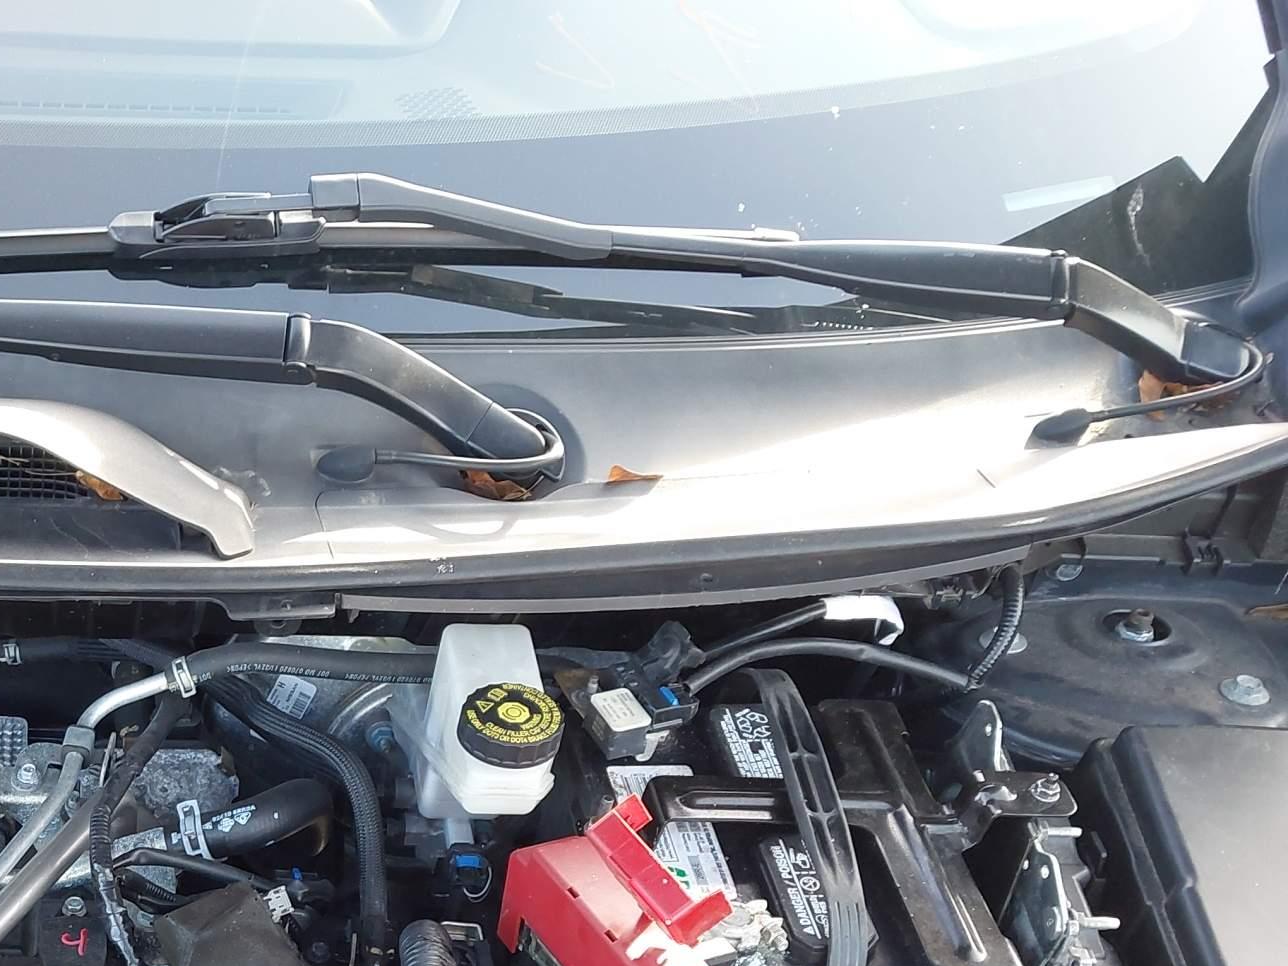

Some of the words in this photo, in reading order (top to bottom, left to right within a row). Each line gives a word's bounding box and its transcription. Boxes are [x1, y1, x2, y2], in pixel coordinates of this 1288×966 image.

[485, 721, 506, 735] CLEAN
[506, 729, 530, 737] FILLER
[499, 734, 510, 742] OR
[769, 845, 793, 879] POISON
[784, 879, 796, 887] /
[787, 887, 812, 926] DANGER
[61, 928, 89, 956] 4
